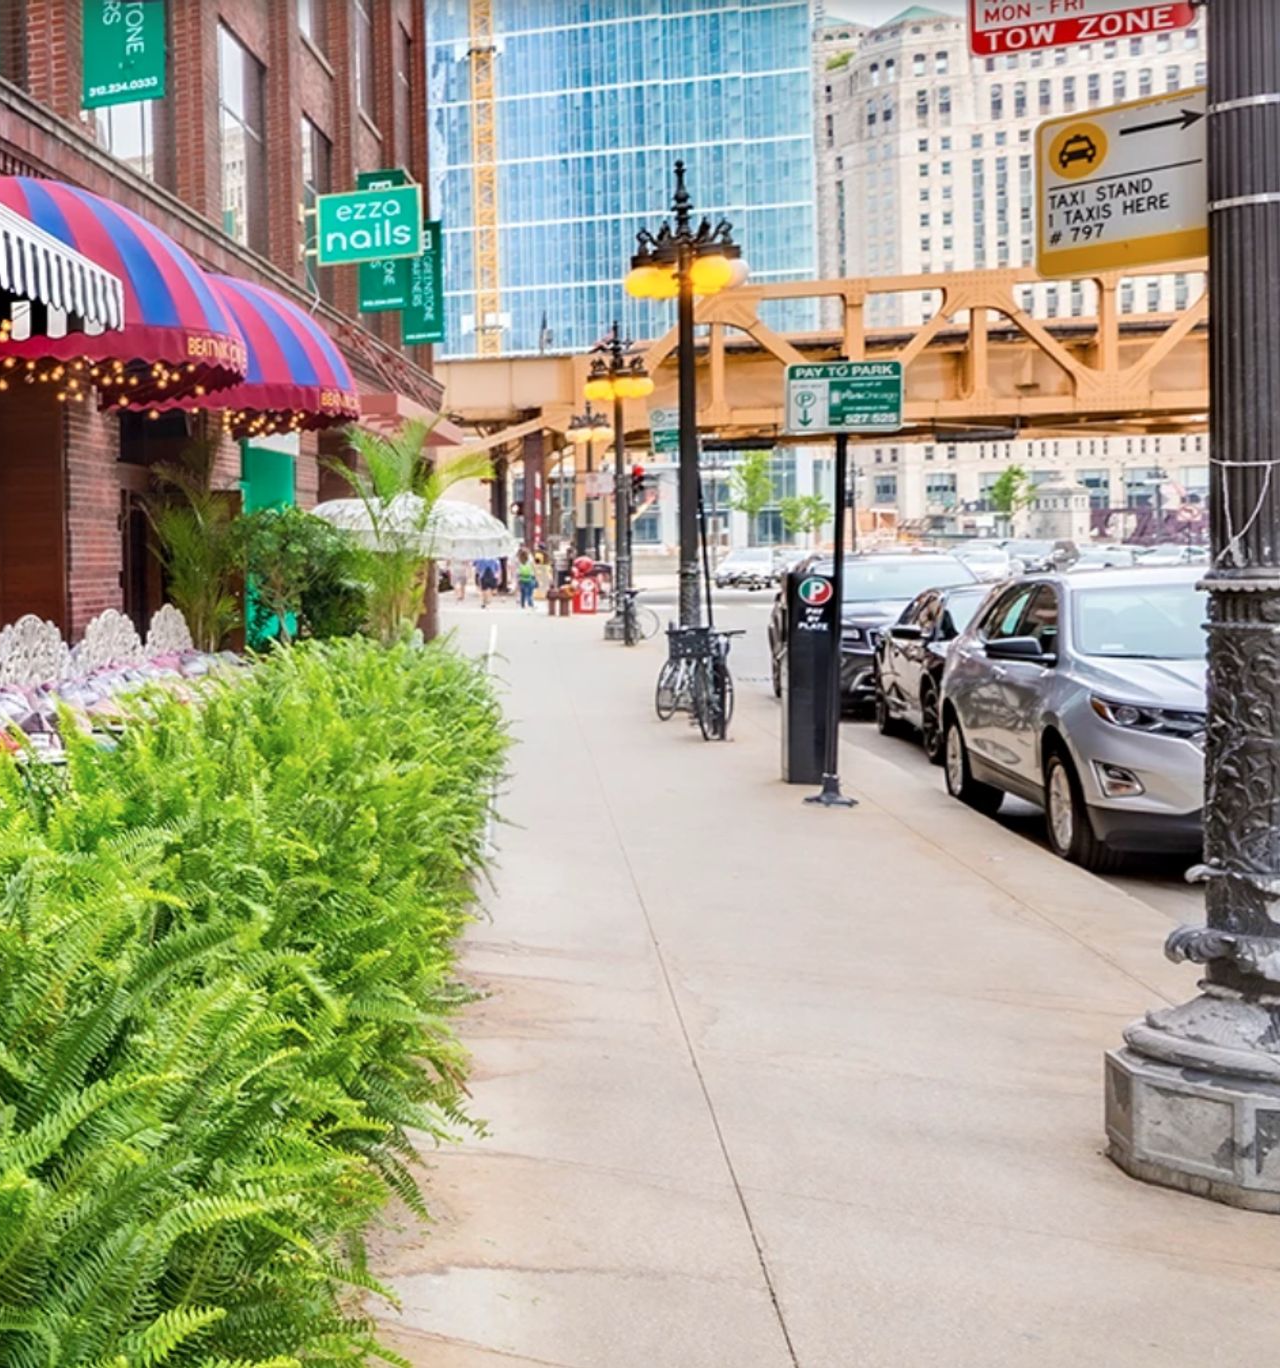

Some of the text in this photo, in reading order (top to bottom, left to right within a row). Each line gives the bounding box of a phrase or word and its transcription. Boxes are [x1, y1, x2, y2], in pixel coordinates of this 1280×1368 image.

[983, 6, 1174, 51] TOW ZONE
[1048, 178, 1153, 210] TAXI STAND
[1064, 203, 1112, 225] TAXIS
[1122, 193, 1170, 215] HERE
[336, 199, 401, 222] ezza
[326, 219, 412, 253] nails
[1049, 223, 1105, 245] # 797
[795, 365, 893, 378] PAY TO PARK
